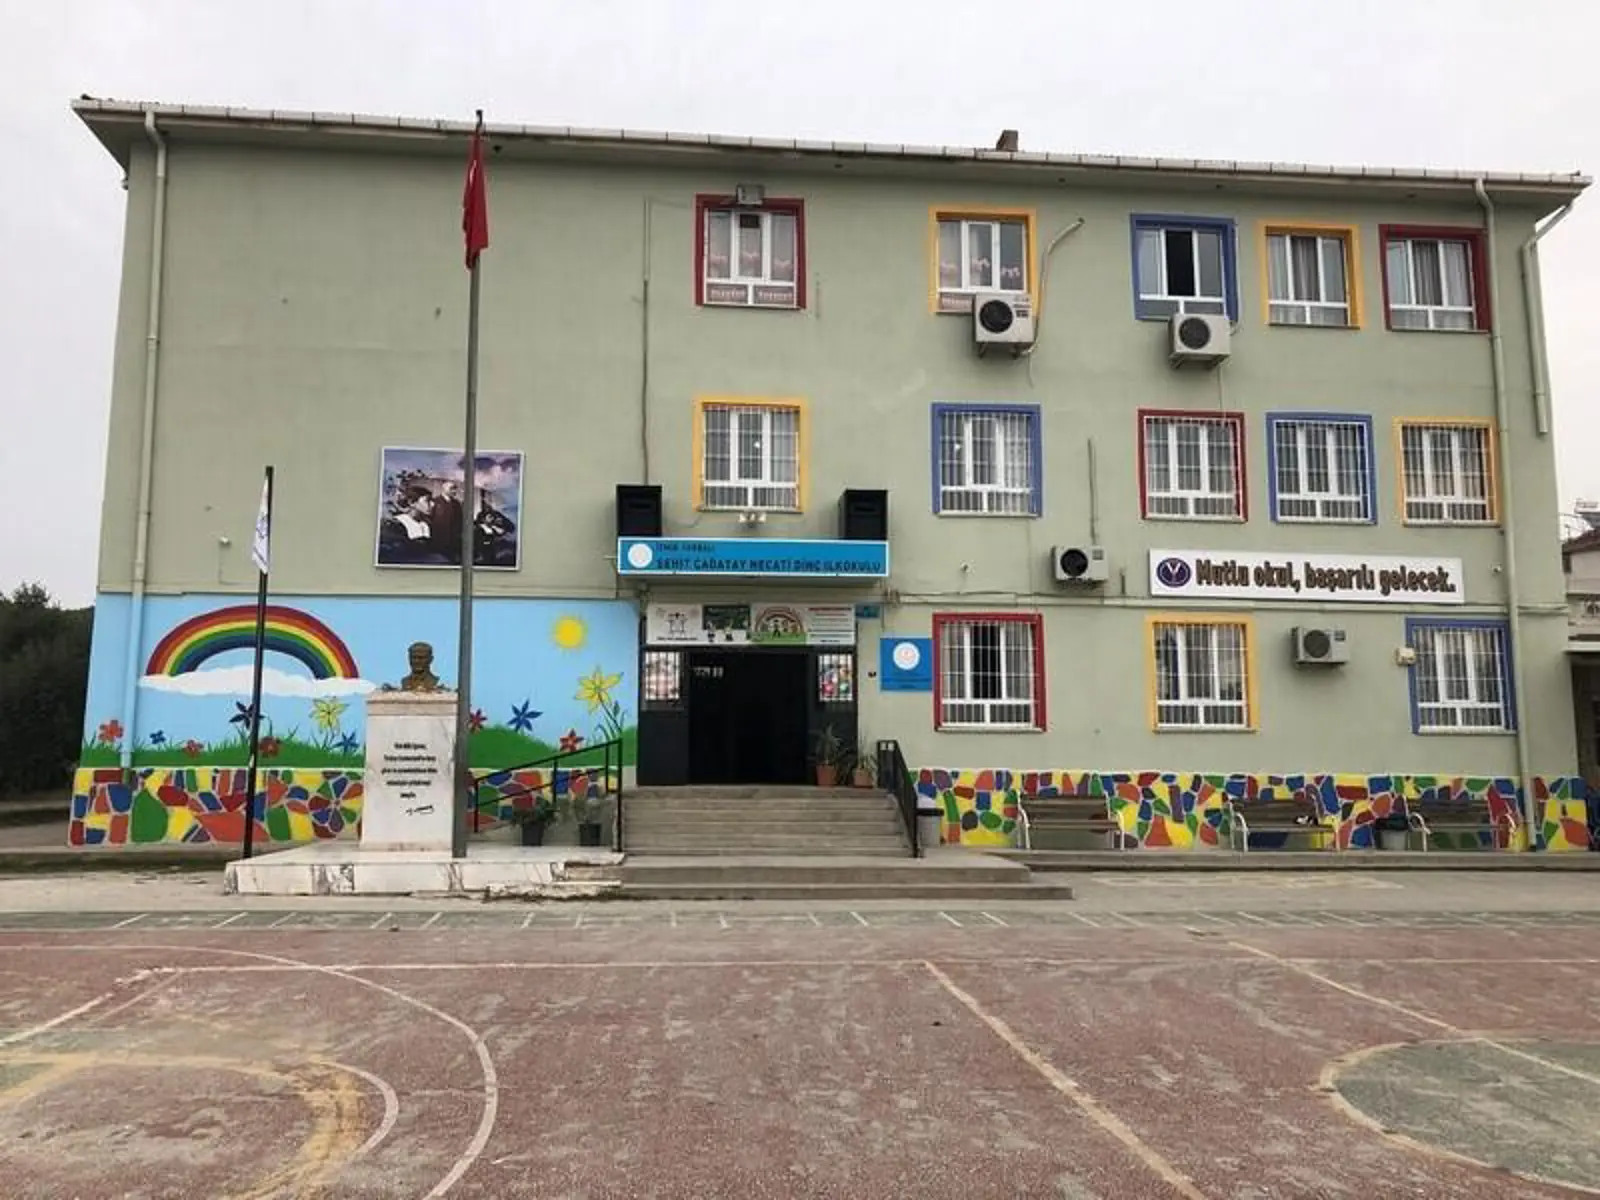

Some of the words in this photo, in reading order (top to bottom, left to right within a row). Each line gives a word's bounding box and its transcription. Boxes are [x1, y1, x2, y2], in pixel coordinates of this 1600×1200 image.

[1196, 558, 1250, 587] Mutlu
[1254, 560, 1301, 593] okul,
[1304, 561, 1375, 593] başarılı
[1379, 564, 1457, 597] gelecek.
